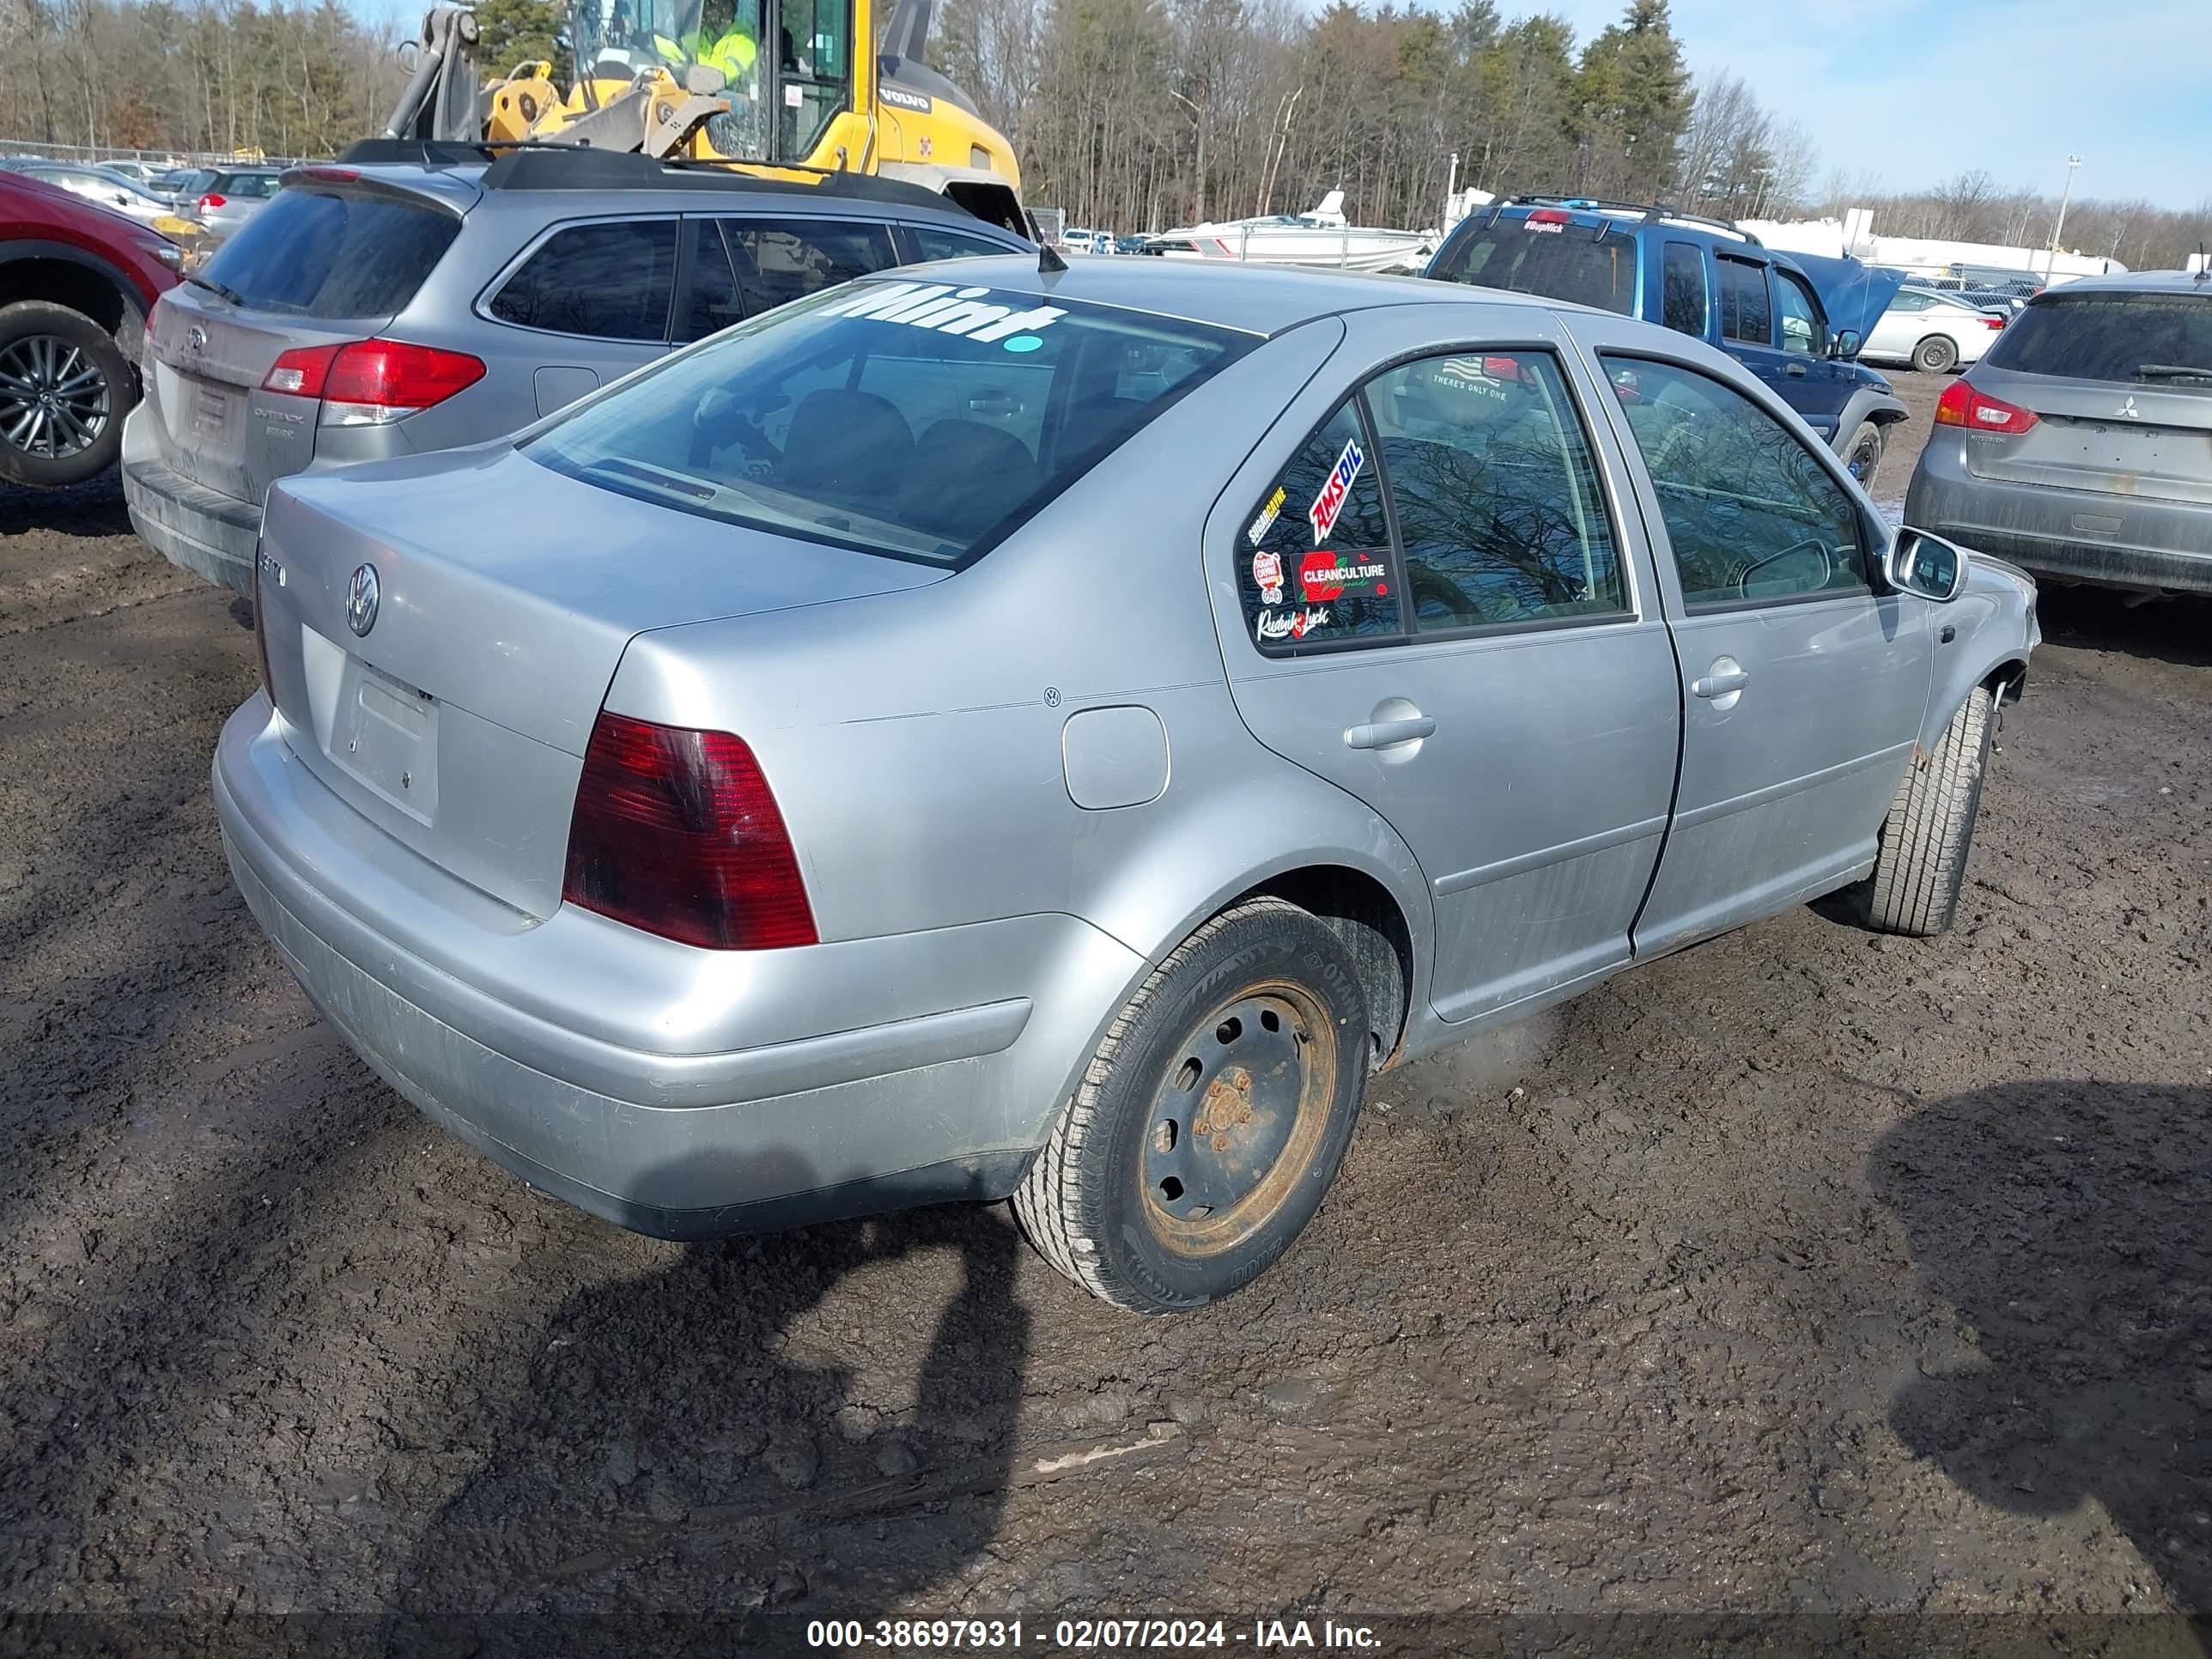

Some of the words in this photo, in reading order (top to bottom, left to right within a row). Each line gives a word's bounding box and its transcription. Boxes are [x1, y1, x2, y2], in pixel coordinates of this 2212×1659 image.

[878, 88, 929, 110] VOLVO
[1433, 374, 1465, 389] THERE'S
[1468, 384, 1488, 394] ONLY
[1311, 444, 1362, 536] AMSOIL
[1304, 564, 1385, 583] CLEANCULTURE
[1301, 606, 1330, 636] Luck
